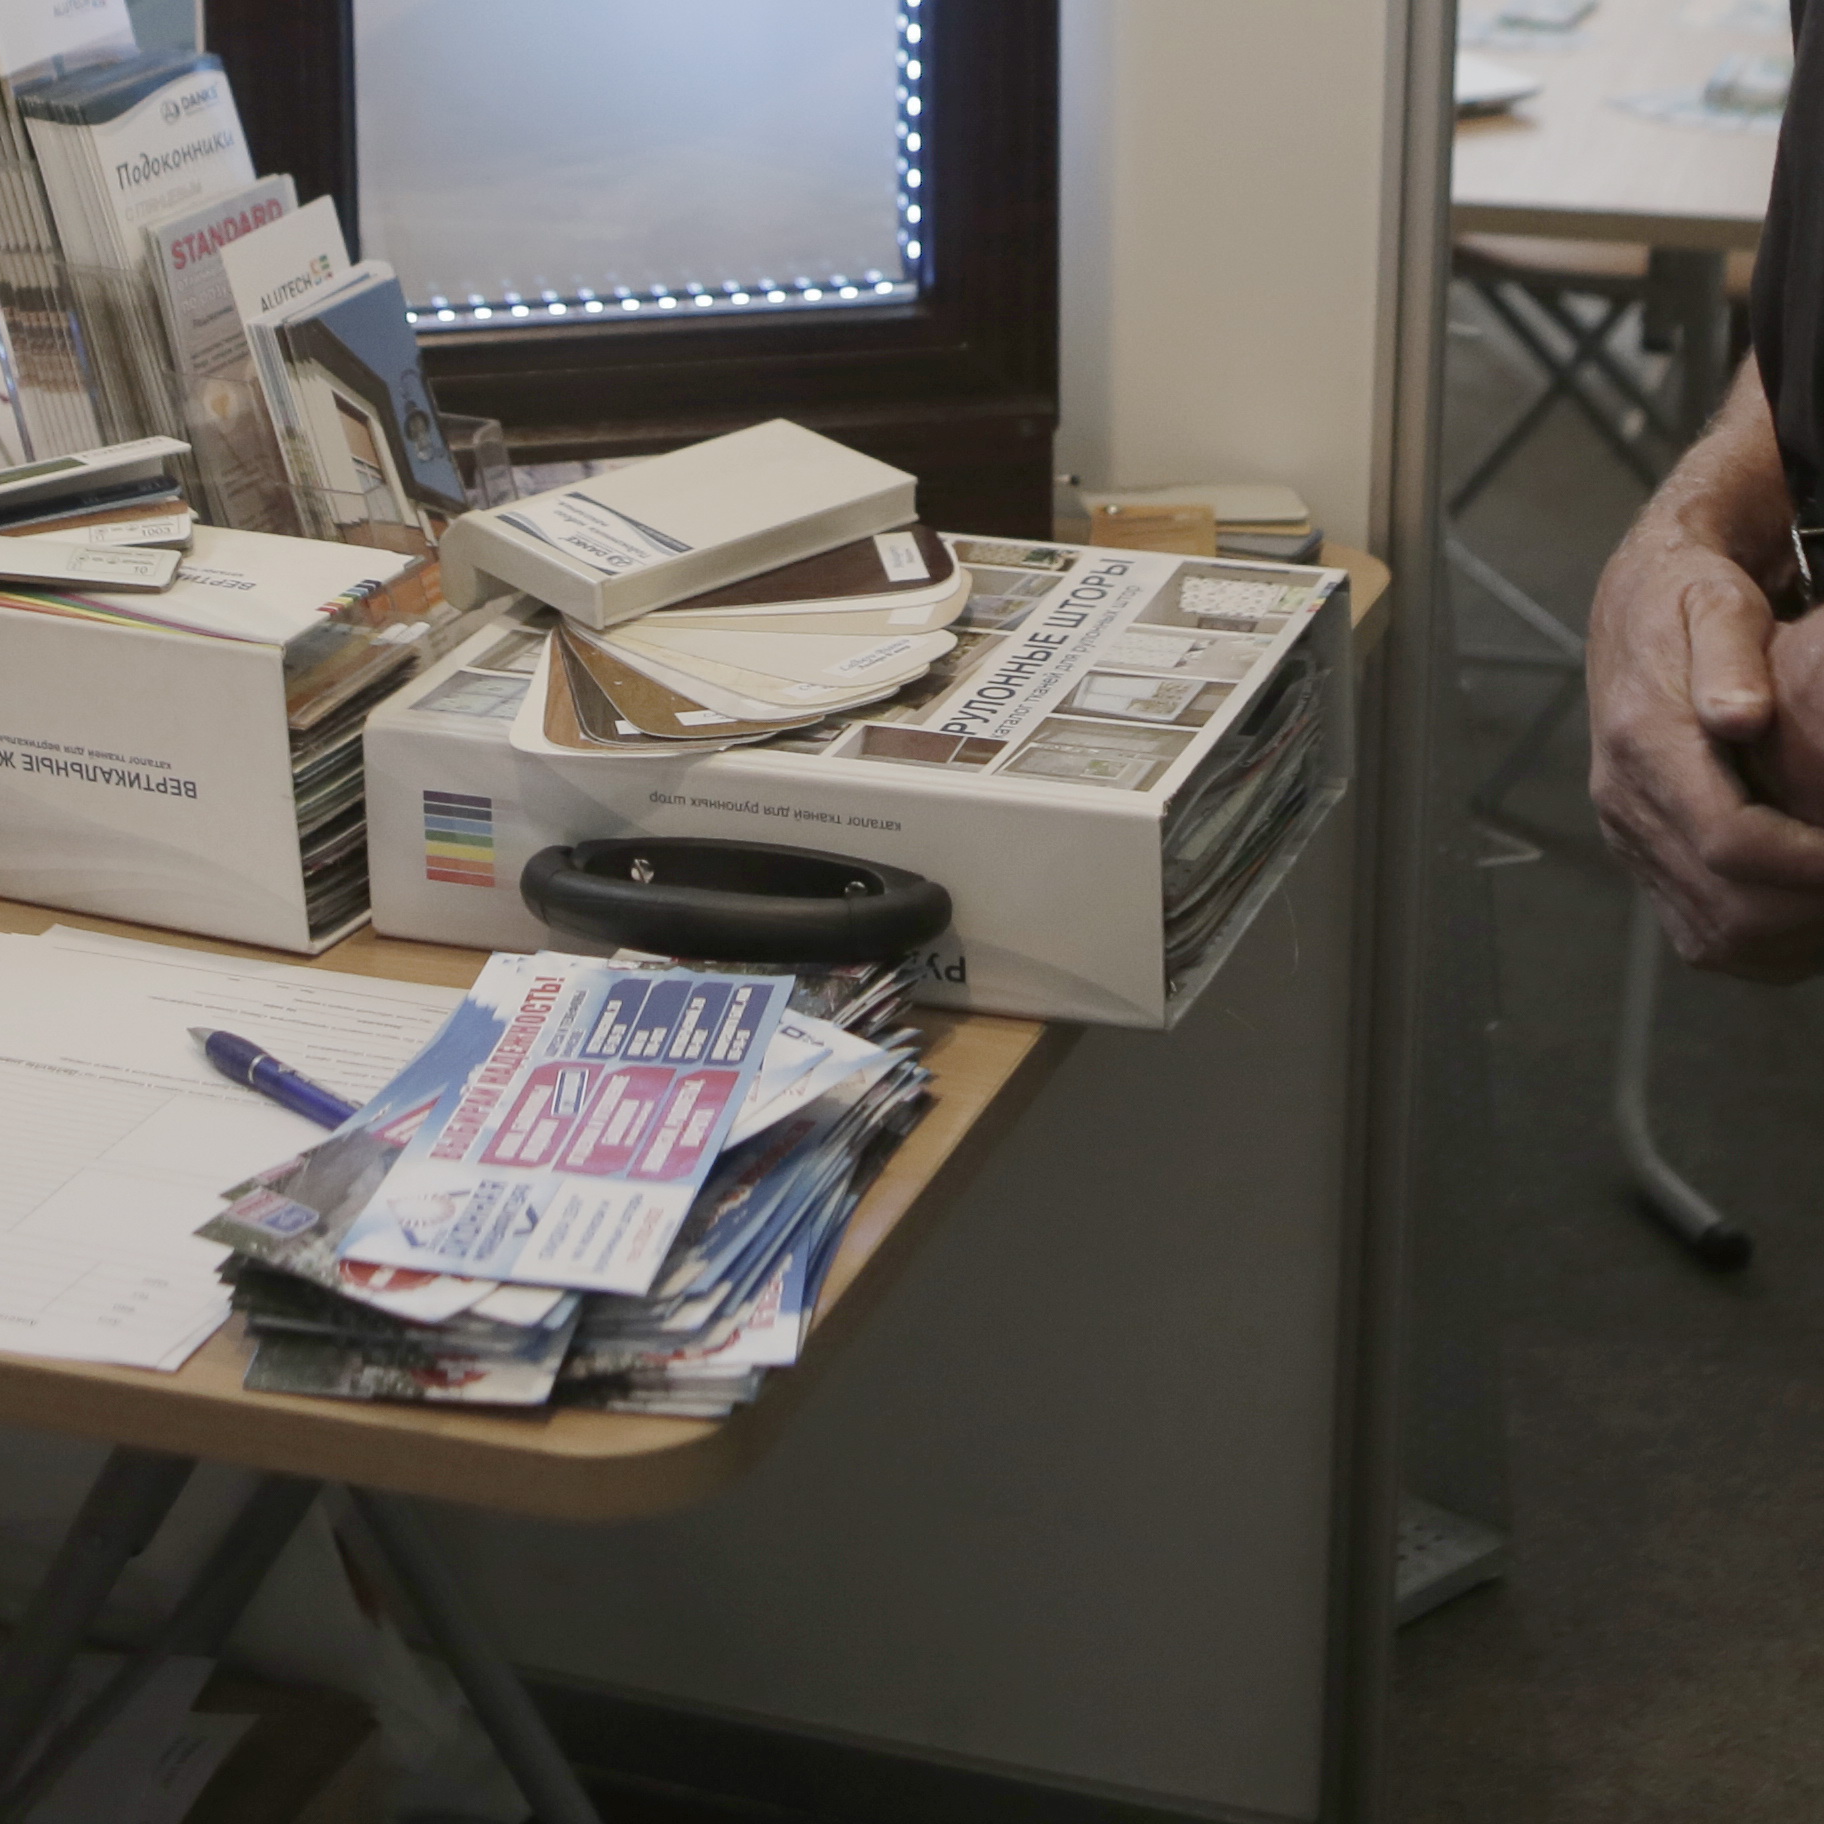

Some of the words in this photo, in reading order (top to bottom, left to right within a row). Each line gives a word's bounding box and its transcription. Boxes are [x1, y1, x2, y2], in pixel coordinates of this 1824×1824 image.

[116, 129, 234, 190] Подоконники
[171, 198, 283, 270] STANDARD
[261, 273, 313, 313] ALUTECH
[941, 631, 1069, 737] РУЛОННЫЕ
[1042, 558, 1135, 629] ШТОРЫ
[990, 705, 1033, 739] каталог
[1029, 670, 1063, 705] тканей
[1054, 650, 1077, 674] для
[1074, 610, 1119, 654] рулонных
[23, 753, 197, 798] ВЕРТИКАЛЬНЫЕ
[650, 791, 686, 806] штор
[691, 796, 759, 815] рулонных
[764, 805, 790, 818] для
[794, 809, 842, 825] тканей
[847, 816, 902, 832] каталог
[429, 1085, 503, 1160] ВЫБИРАЙ
[477, 975, 565, 1084] НАДЕЖНОСТЬ!
